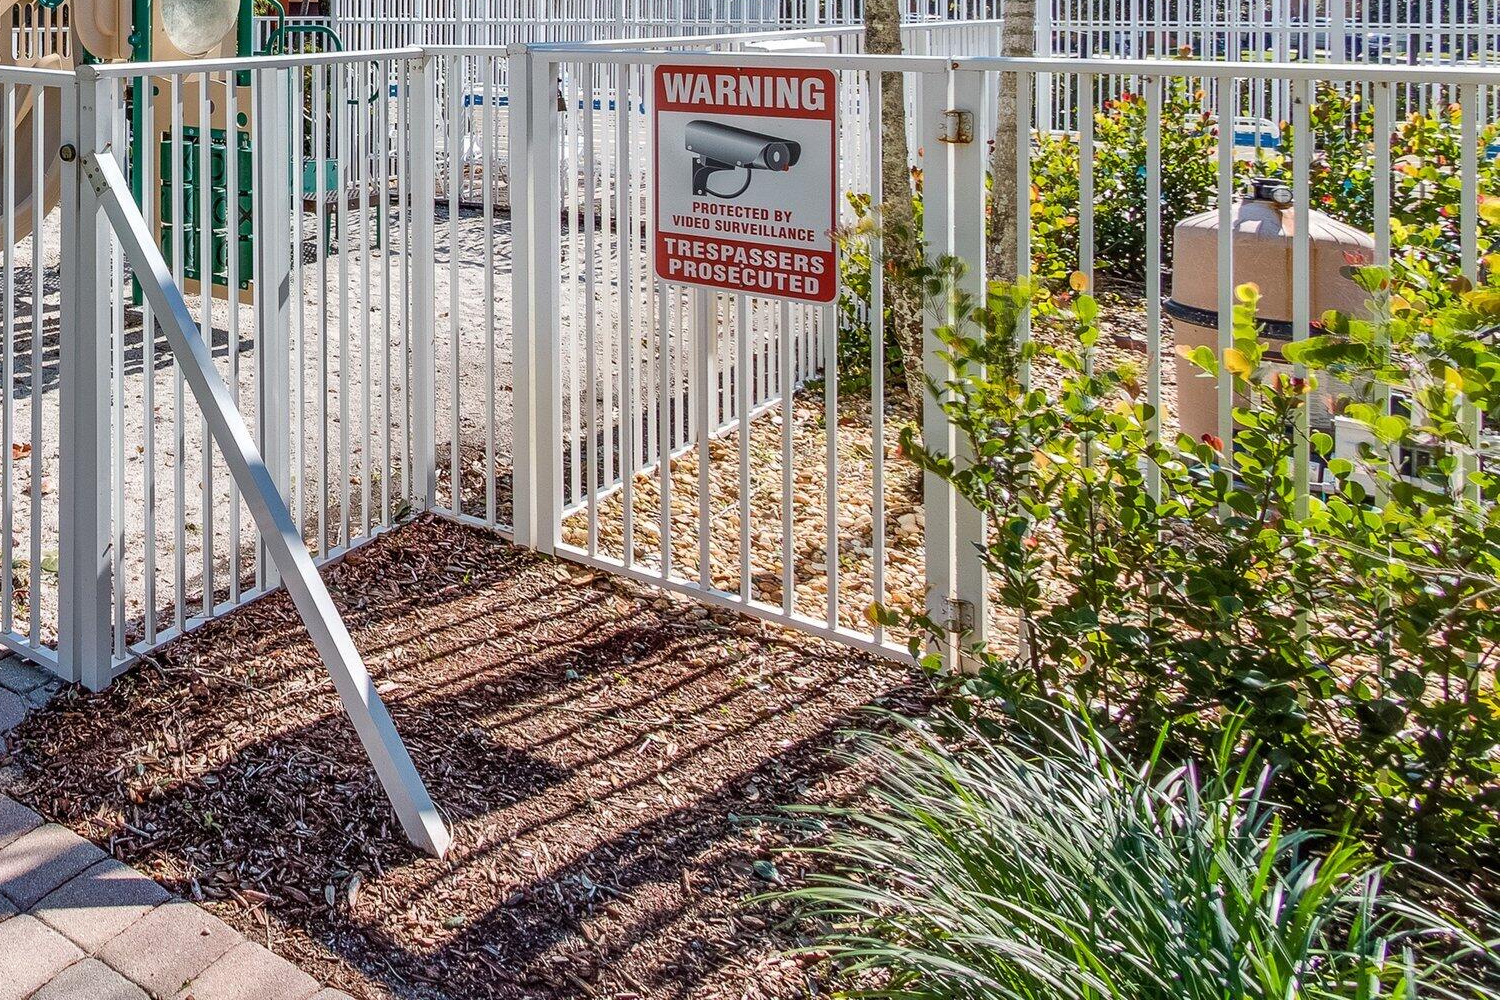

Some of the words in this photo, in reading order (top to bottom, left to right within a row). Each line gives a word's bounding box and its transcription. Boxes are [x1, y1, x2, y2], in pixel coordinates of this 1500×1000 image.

[663, 73, 825, 111] WARNING
[673, 215, 710, 229] VIDEO
[715, 220, 814, 241] SURVEILLANCE
[693, 202, 769, 220] PROTECTED
[775, 210, 792, 223] BY
[664, 238, 824, 274] TRESPASSERS
[669, 259, 819, 294] PROSECUTED
